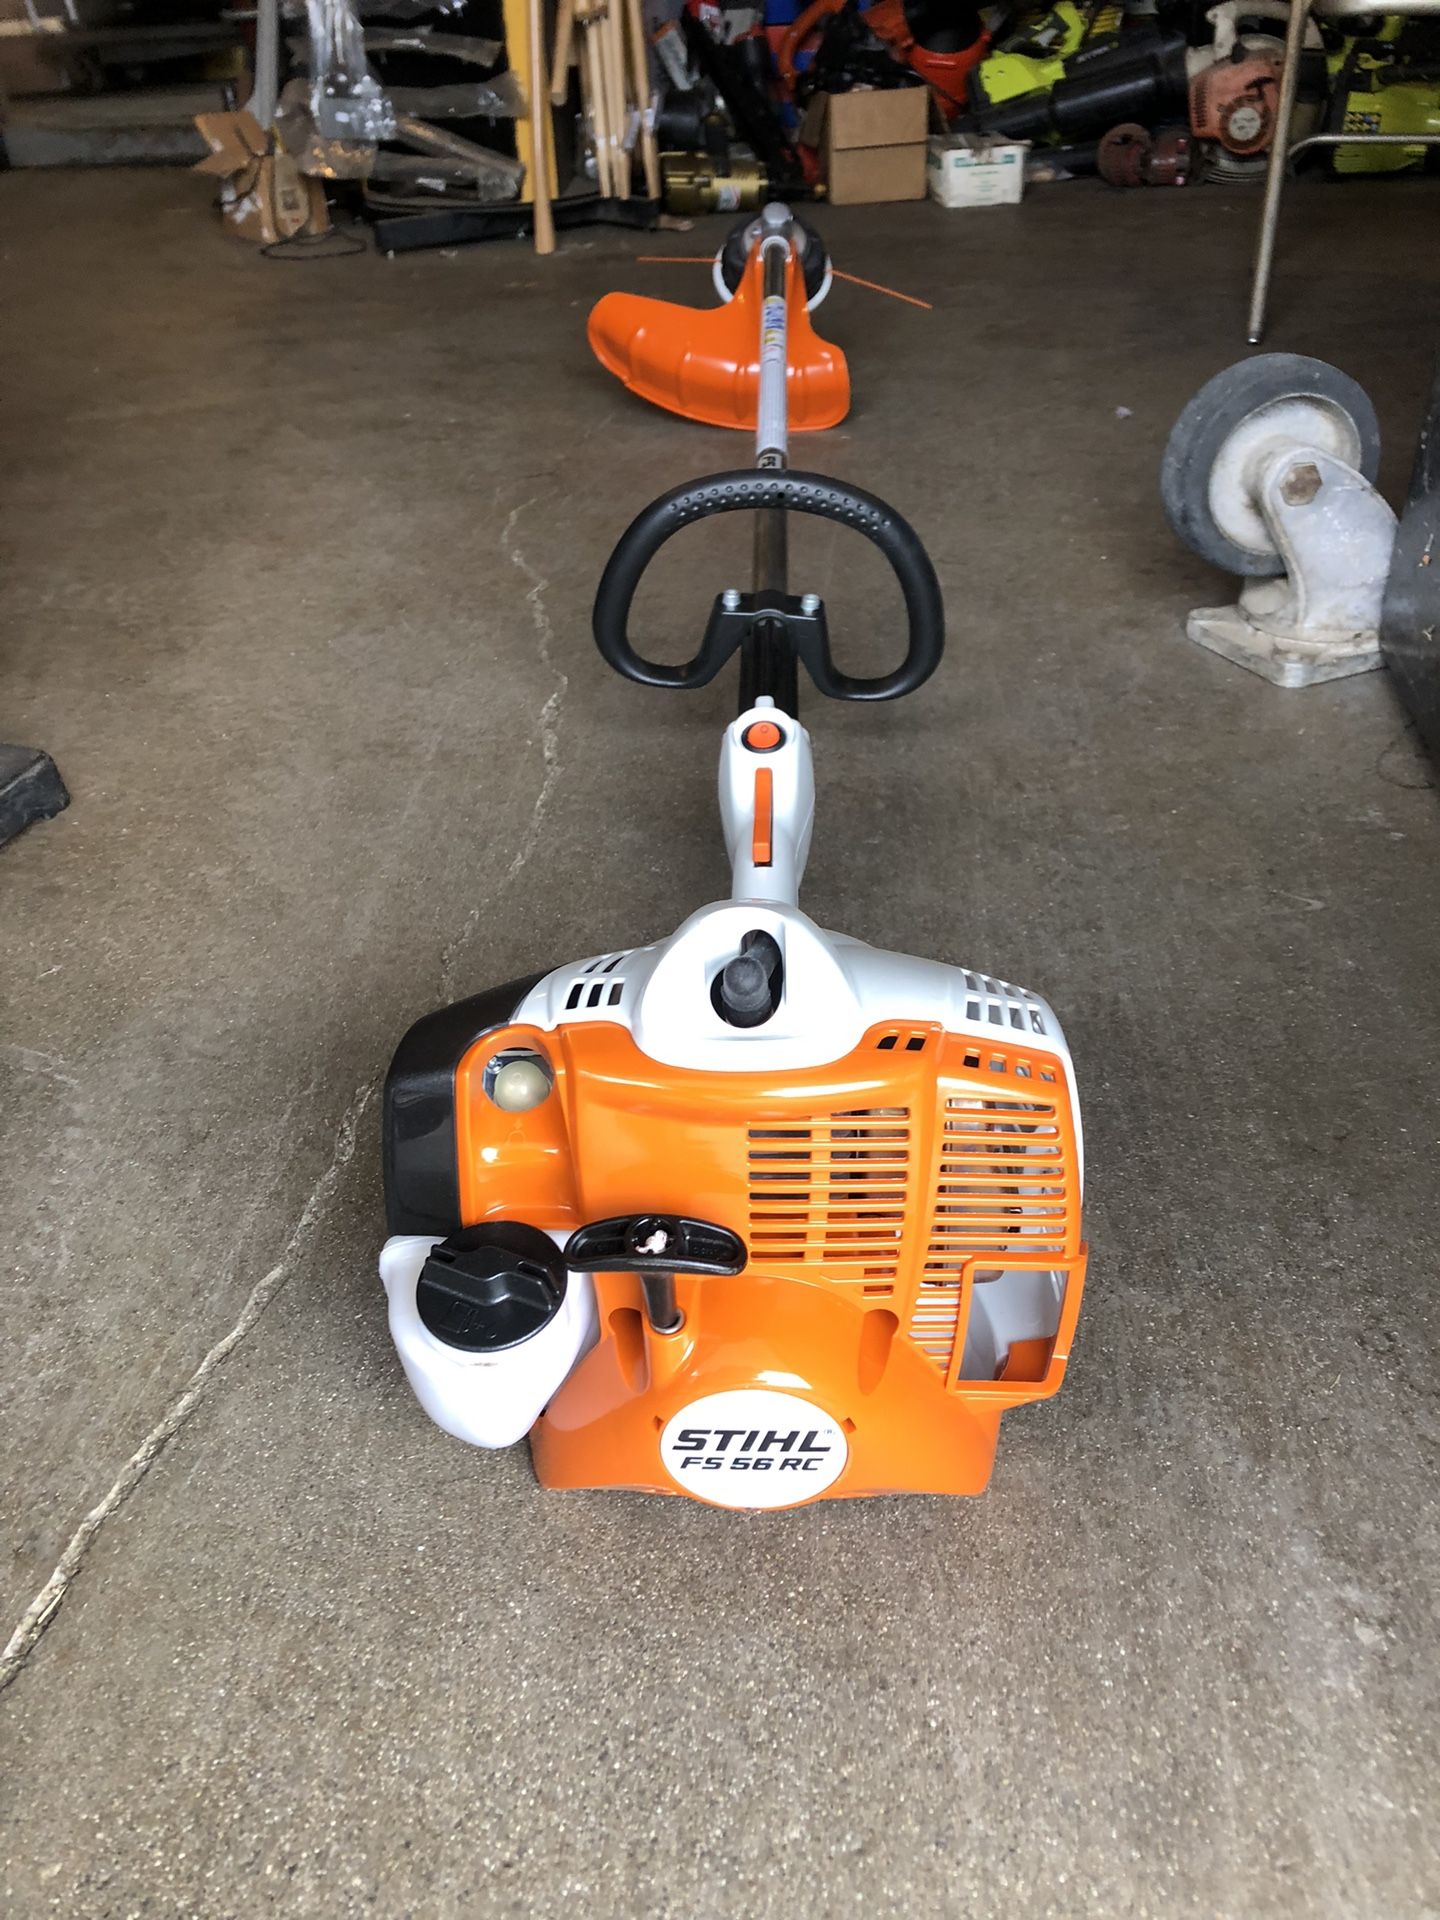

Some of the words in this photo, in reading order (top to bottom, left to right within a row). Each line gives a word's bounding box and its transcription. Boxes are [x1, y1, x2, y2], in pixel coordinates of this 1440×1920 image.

[672, 1429, 831, 1452] STIHL
[680, 1457, 724, 1470] FS
[729, 1458, 774, 1470] 56
[778, 1458, 824, 1471] RC
